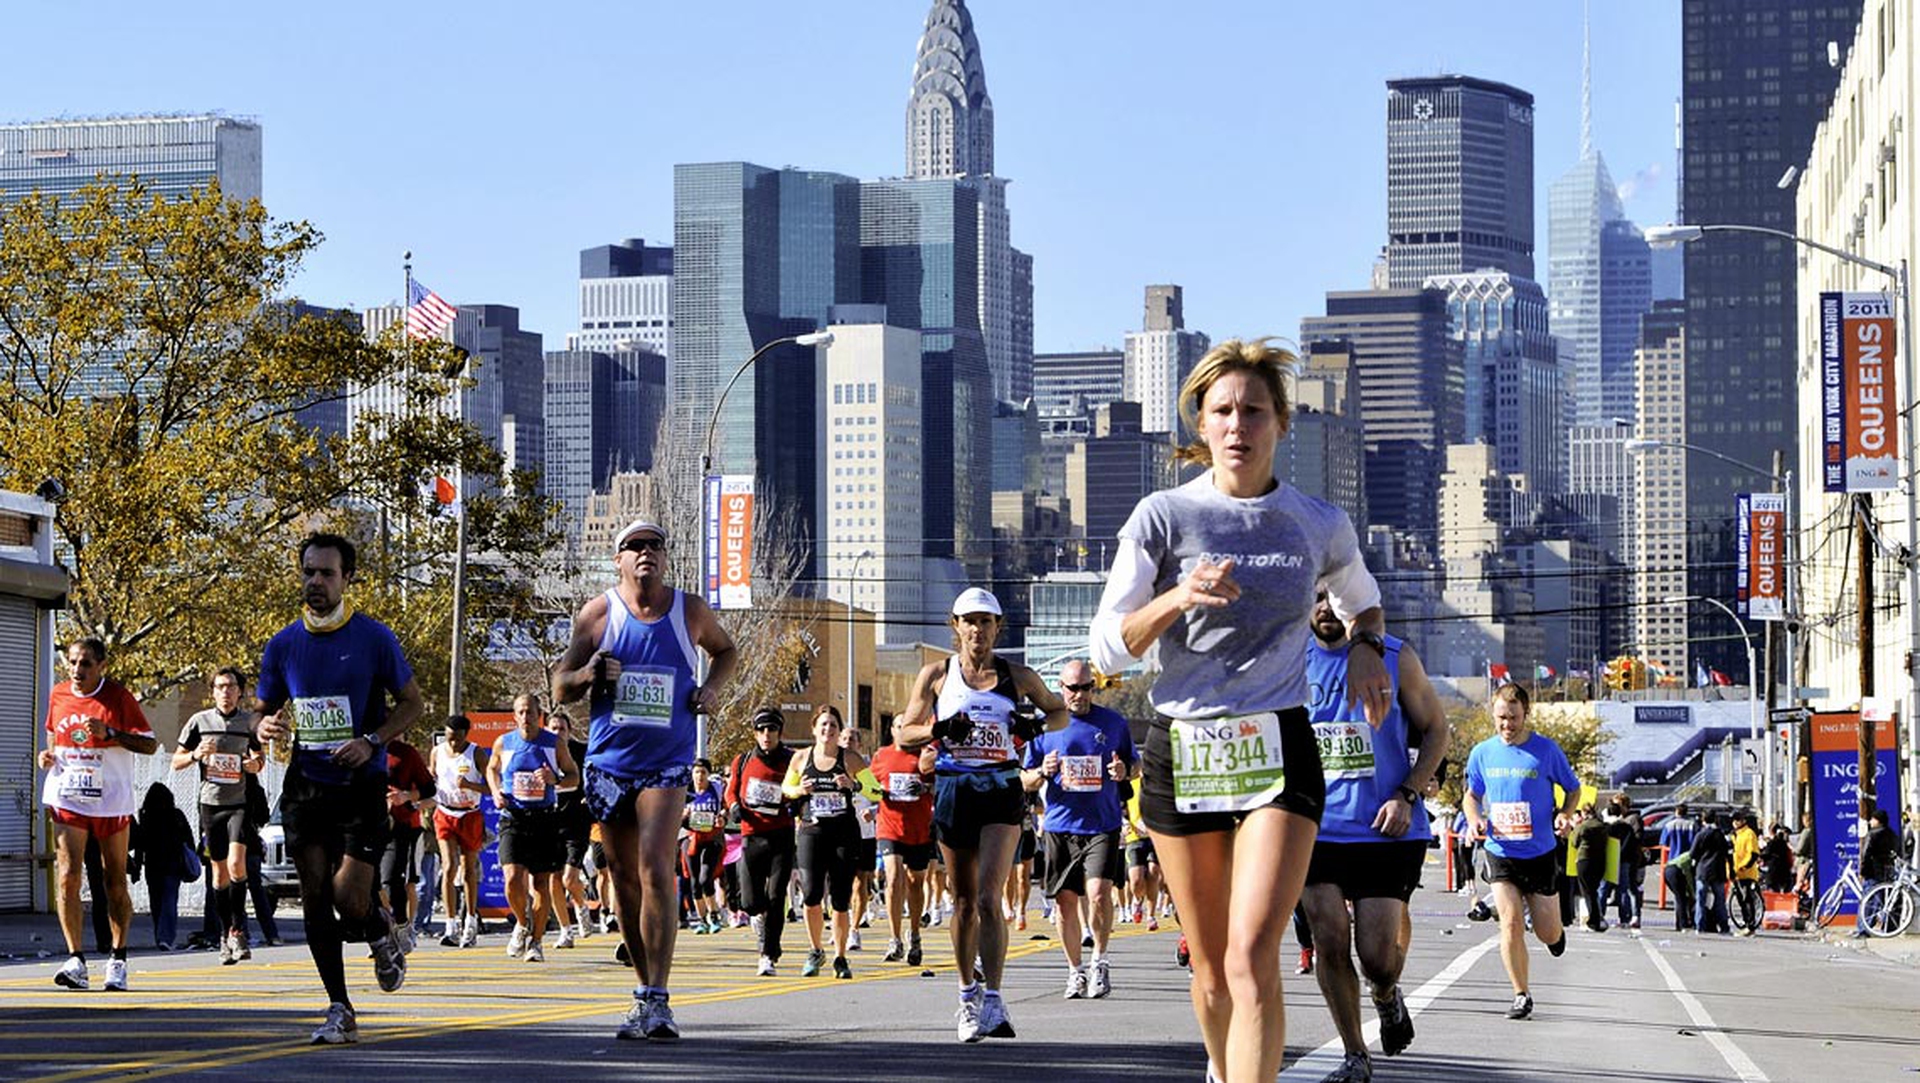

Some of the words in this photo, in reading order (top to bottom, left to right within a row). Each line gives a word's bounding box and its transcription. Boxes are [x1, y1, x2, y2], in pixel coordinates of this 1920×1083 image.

[1849, 304, 1889, 315] 2011
[1823, 299, 1839, 358] MARATHON
[1825, 360, 1840, 385] CITY
[1857, 322, 1886, 452] QUEENS
[1825, 386, 1840, 416] YORK
[1827, 417, 1841, 442] NEW
[1827, 465, 1841, 485] THE
[726, 496, 746, 582] QUEENS
[1247, 554, 1269, 567] TO
[1269, 554, 1303, 568] RUN
[1758, 514, 1776, 594] QUEENS
[627, 676, 650, 685] ING
[622, 685, 665, 703] 19-631
[302, 701, 325, 711] ING
[299, 708, 347, 728] 20-048
[1192, 726, 1233, 742] ING
[1189, 736, 1269, 773] 17-344
[1823, 763, 1860, 779] ING
